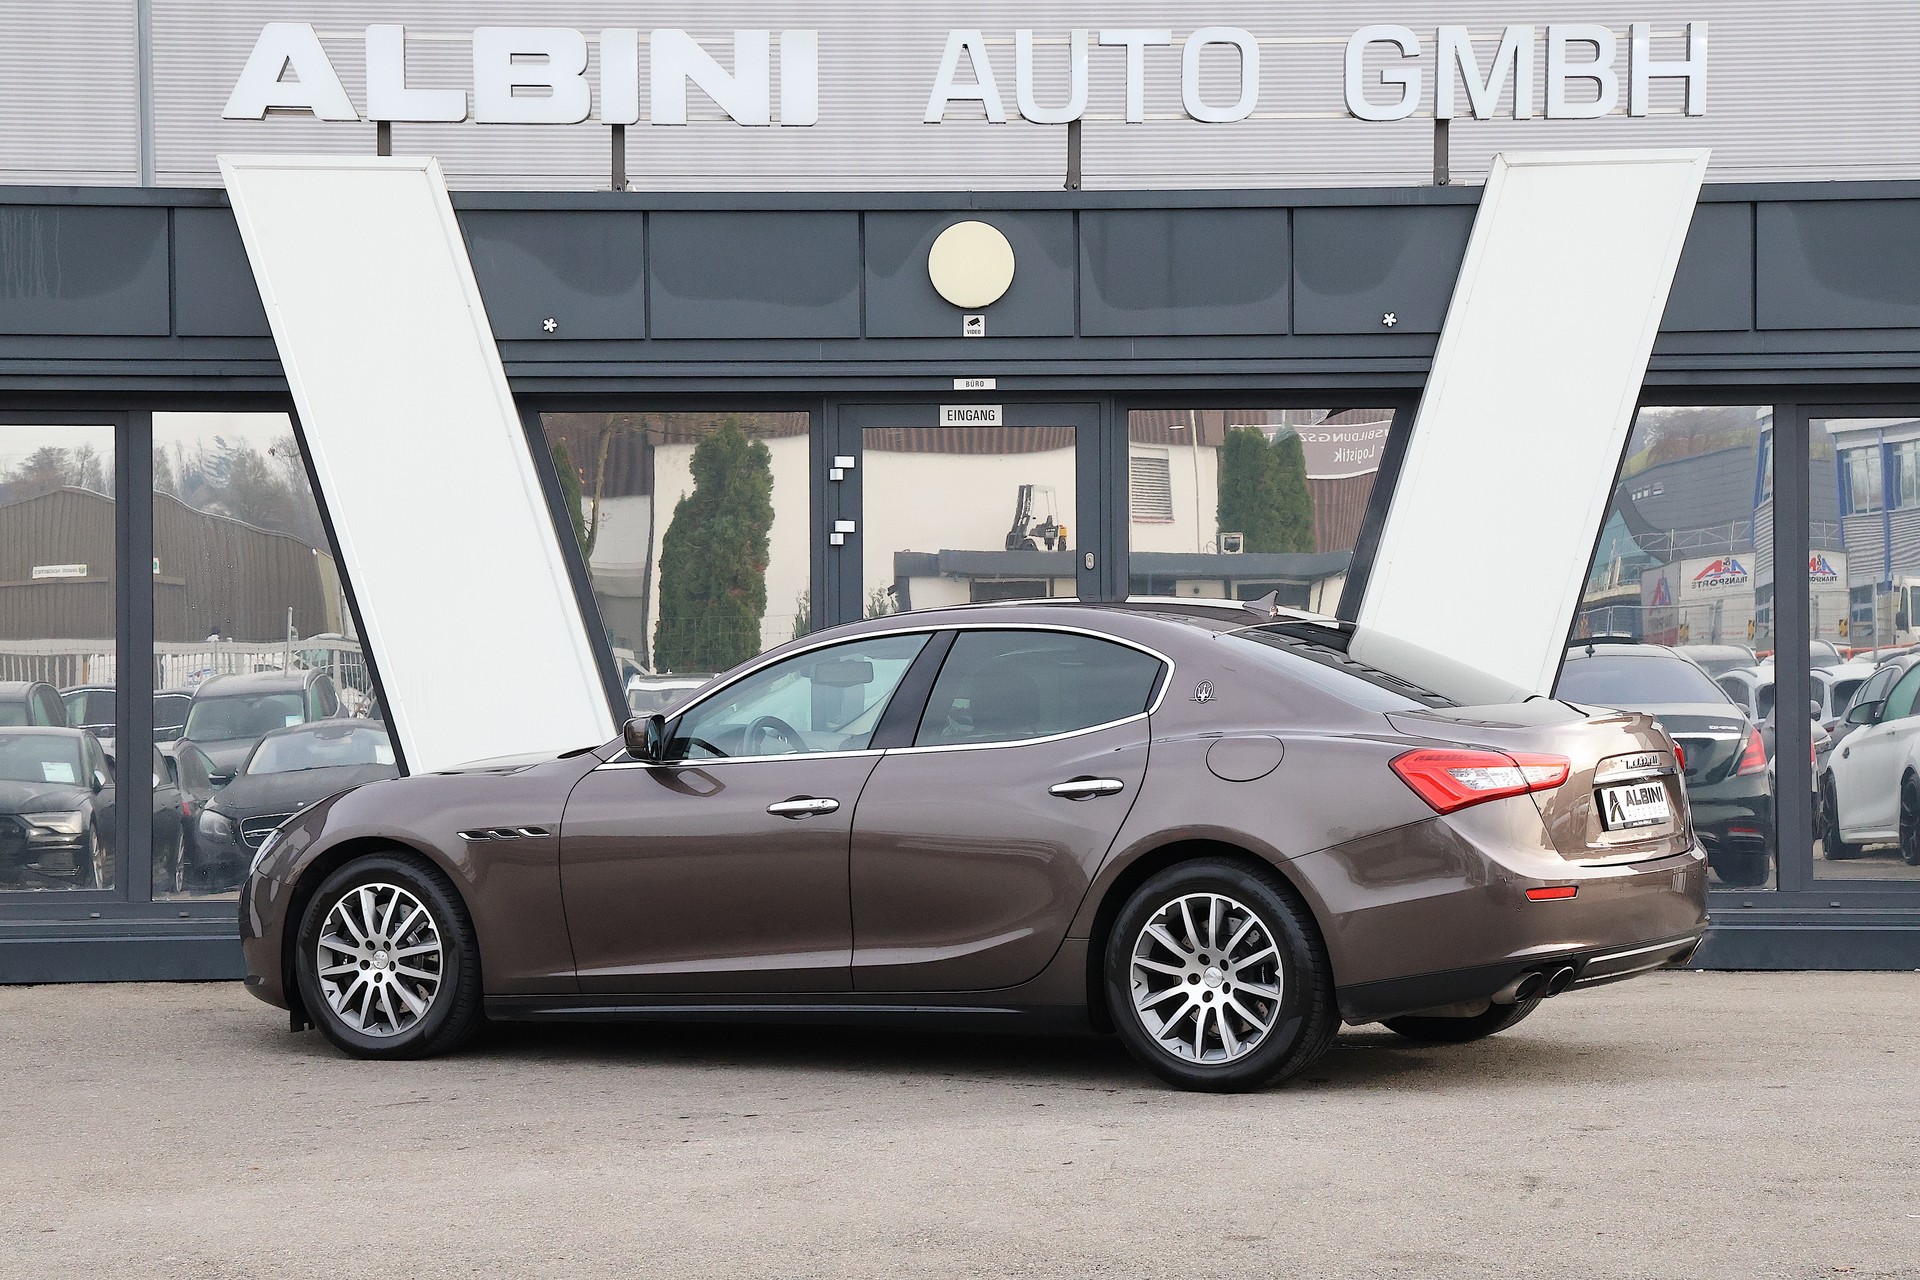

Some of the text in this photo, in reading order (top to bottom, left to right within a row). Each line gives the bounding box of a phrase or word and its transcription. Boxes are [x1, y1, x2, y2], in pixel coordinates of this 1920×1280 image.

[220, 20, 1709, 127] ALBINI AUTO GMBH
[965, 379, 985, 388] BÜRO
[947, 409, 995, 421] EINGANG
[1625, 786, 1664, 807] ALBINI
